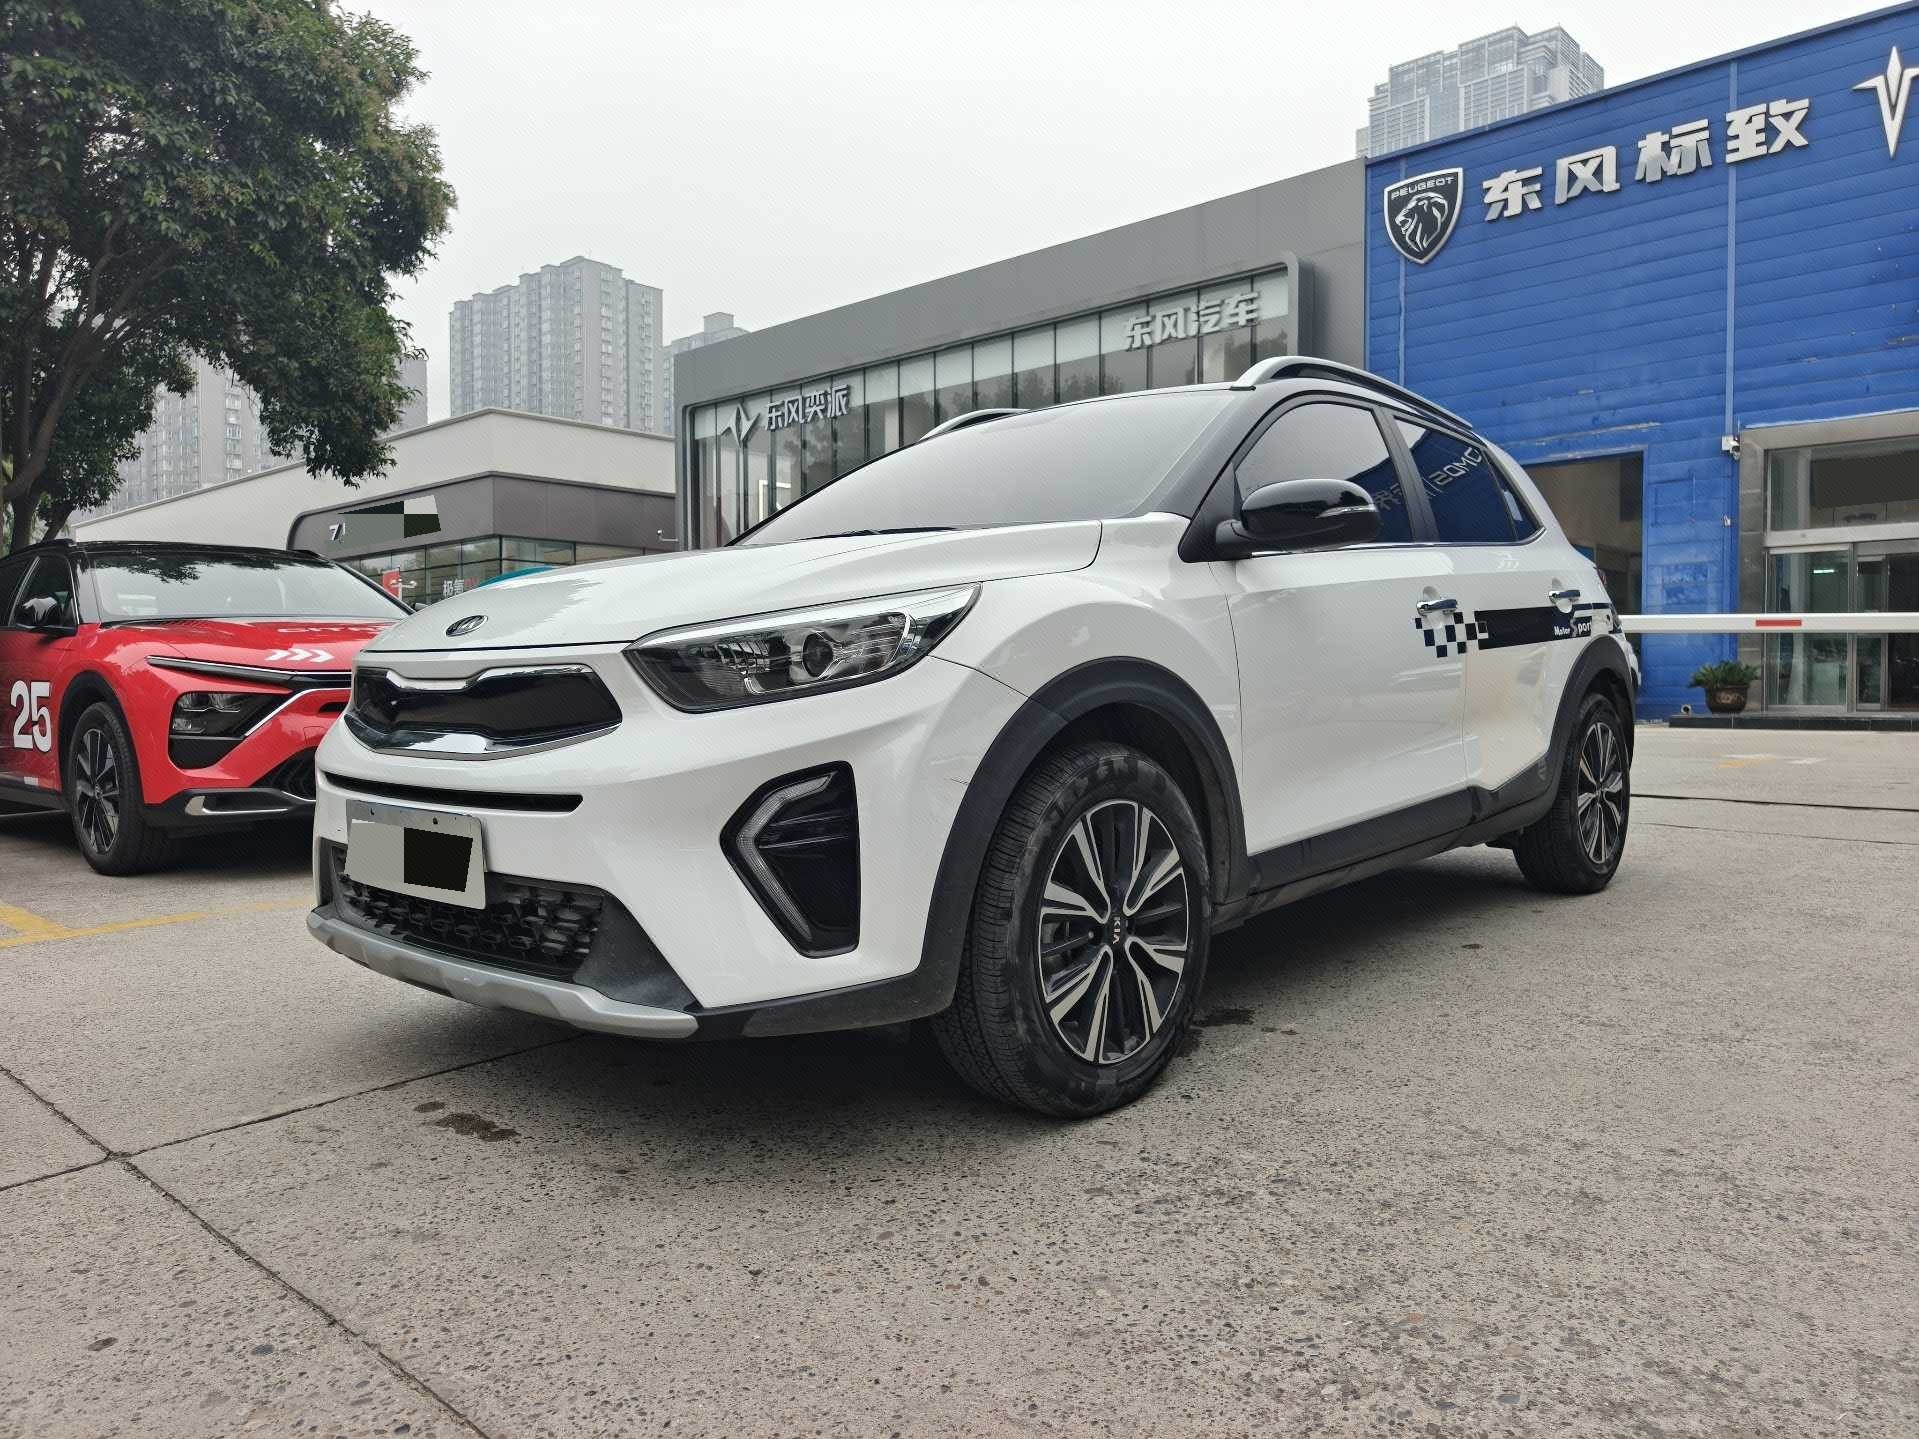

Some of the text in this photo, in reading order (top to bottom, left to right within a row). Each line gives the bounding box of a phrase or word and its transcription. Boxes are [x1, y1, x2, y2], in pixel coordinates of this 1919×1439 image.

[1482, 98, 1810, 221] 东风标致
[1390, 176, 1455, 200] PEUGEOT
[1126, 292, 1260, 351] 东风汽车
[765, 384, 849, 430] 东风奕派
[10, 680, 52, 753] 25
[1112, 917, 1121, 944] KIA
